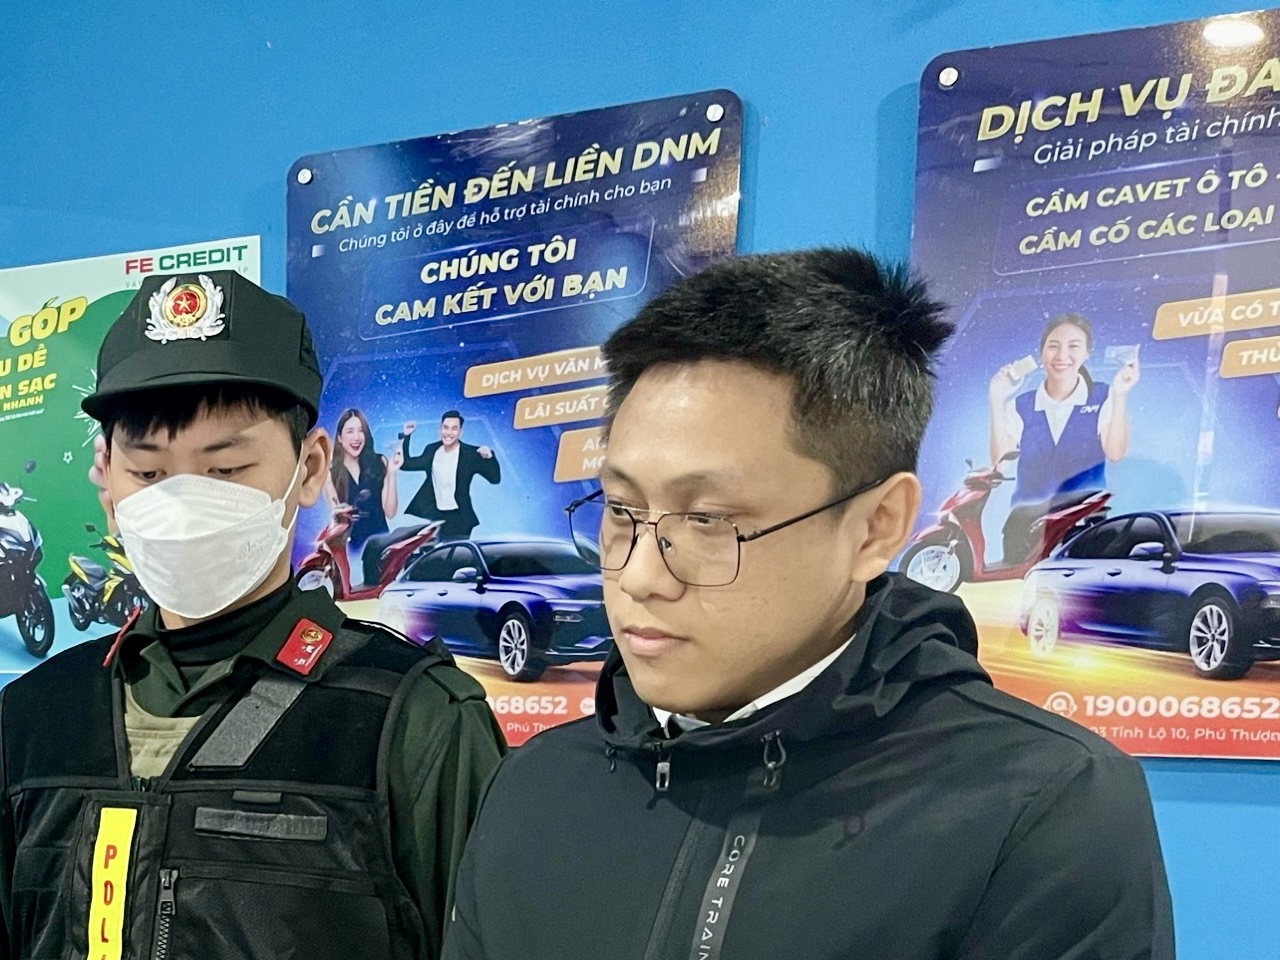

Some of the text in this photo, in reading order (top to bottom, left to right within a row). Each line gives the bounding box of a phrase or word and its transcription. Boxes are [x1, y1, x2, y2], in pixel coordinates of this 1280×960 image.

[976, 57, 1280, 144] DỊCH VỤ ĐA
[1033, 107, 1280, 165] Giải pháp tài chính
[310, 128, 721, 235] CẦN TIỀN ĐẾN LIỀN DNM
[1025, 188, 1089, 218] CẦM
[1096, 176, 1191, 208] CAVET
[1196, 169, 1221, 194] Ô
[1228, 162, 1268, 190] TÔ
[338, 175, 672, 254] Chúng tôi ở đây để hỗ trợ tài chính cho bạn
[1018, 204, 1275, 256] CẦM CỐ CÁC LOẠI
[125, 257, 153, 275] FE
[159, 245, 248, 271] CREDIT
[420, 233, 578, 286] CHÚNG TÔI
[8, 296, 88, 347] GÓP
[374, 266, 629, 326] CAM KẾT VỚI BẠN
[1178, 306, 1224, 328] VỪA
[1231, 298, 1263, 321] CÓ
[18, 373, 58, 395] SẠC
[481, 369, 522, 389] DỊCH
[526, 364, 550, 382] VỤ
[554, 357, 589, 376] VĂN
[3, 394, 44, 411] NHANH
[523, 404, 550, 420] LÃI
[554, 393, 600, 416] SUẤT
[507, 722, 530, 733] Phú
[1083, 695, 1280, 719] 1900068652
[1148, 727, 1167, 740] Lộ
[1170, 728, 1189, 740] 10,
[1194, 728, 1226, 740] Phú
[1230, 728, 1280, 743] Thượn
[717, 835, 745, 888] CORE
